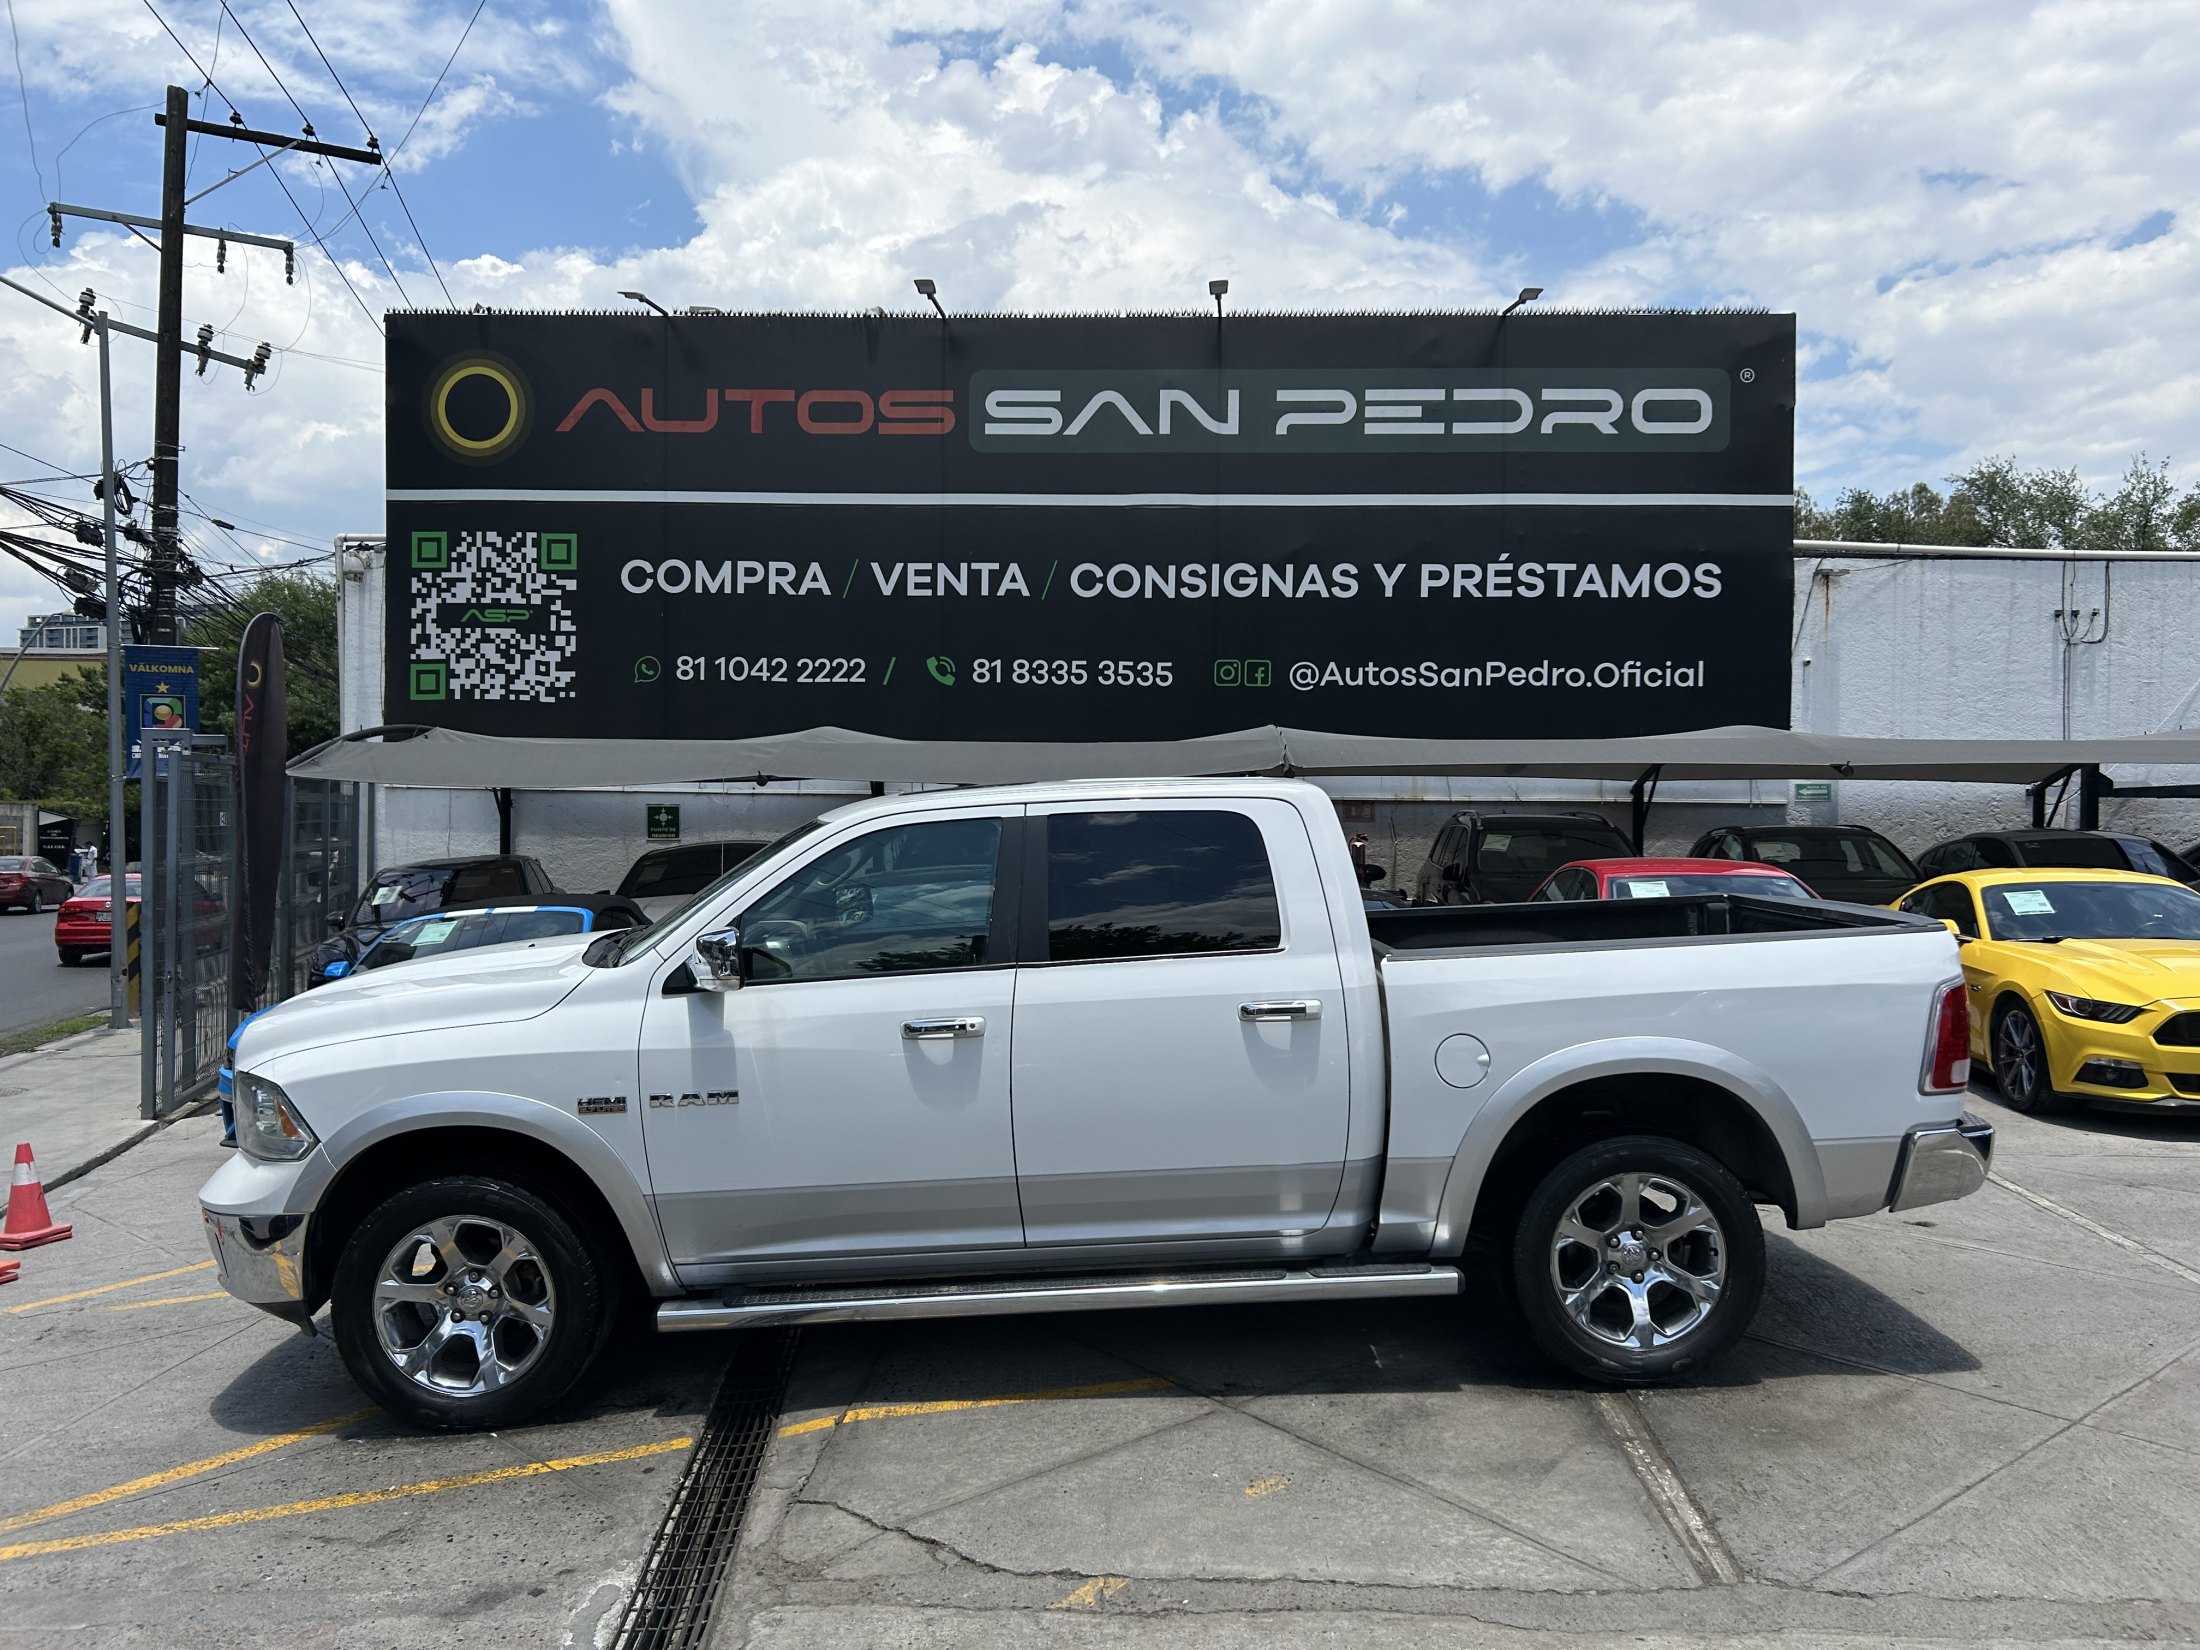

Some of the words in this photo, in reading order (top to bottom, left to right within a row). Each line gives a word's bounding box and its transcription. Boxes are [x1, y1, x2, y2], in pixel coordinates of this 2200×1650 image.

[555, 387, 956, 435] AUTOS
[984, 389, 1240, 436] SAN
[1275, 388, 1713, 436] PEDRO
[620, 558, 832, 596] COMPRA
[870, 561, 1031, 597] VENTA
[1070, 562, 1359, 599] CONSIGNAS
[1373, 563, 1407, 598] Y
[1420, 552, 1722, 599] PRÉSTAMOS
[460, 608, 530, 623] ASP
[676, 655, 705, 682] 81
[714, 656, 788, 683] 1042
[796, 657, 866, 684] 2222
[972, 658, 1002, 684] 81
[1012, 658, 1088, 685] 8335
[1097, 659, 1173, 687] 3535
[1289, 659, 1704, 691] @AutosSanPedro.Oficial
[649, 1090, 739, 1107] RAM
